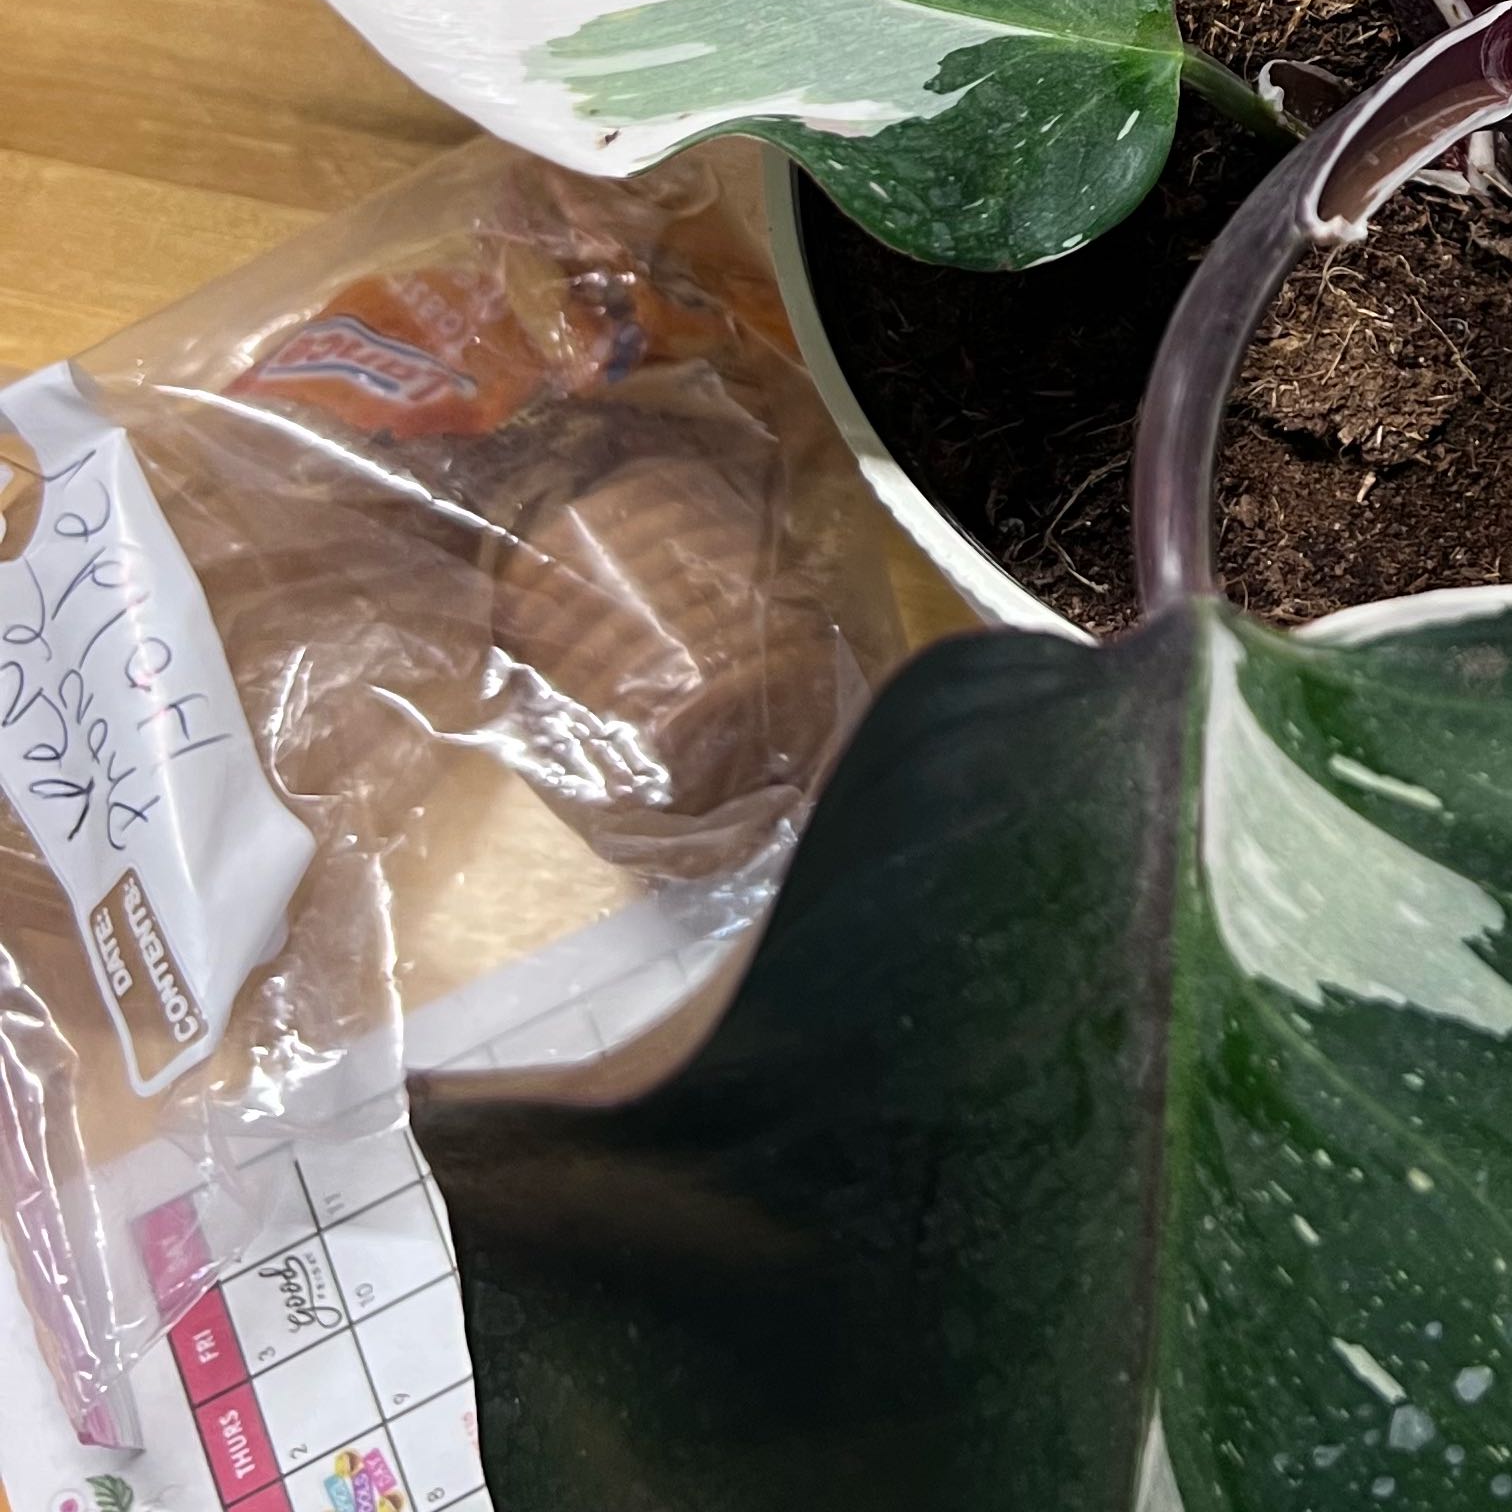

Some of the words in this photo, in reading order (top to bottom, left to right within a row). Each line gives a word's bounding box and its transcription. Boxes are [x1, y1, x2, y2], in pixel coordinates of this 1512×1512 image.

[95, 906, 134, 999] DATE:
[123, 876, 199, 1043] CONTENTS:
[354, 1282, 375, 1308] 10
[192, 1328, 220, 1365] FRI
[258, 1345, 276, 1362] 3
[392, 1392, 411, 1406] 9
[219, 1408, 256, 1480] THURS
[288, 1442, 308, 1460] 2
[426, 1487, 445, 1503] 8
